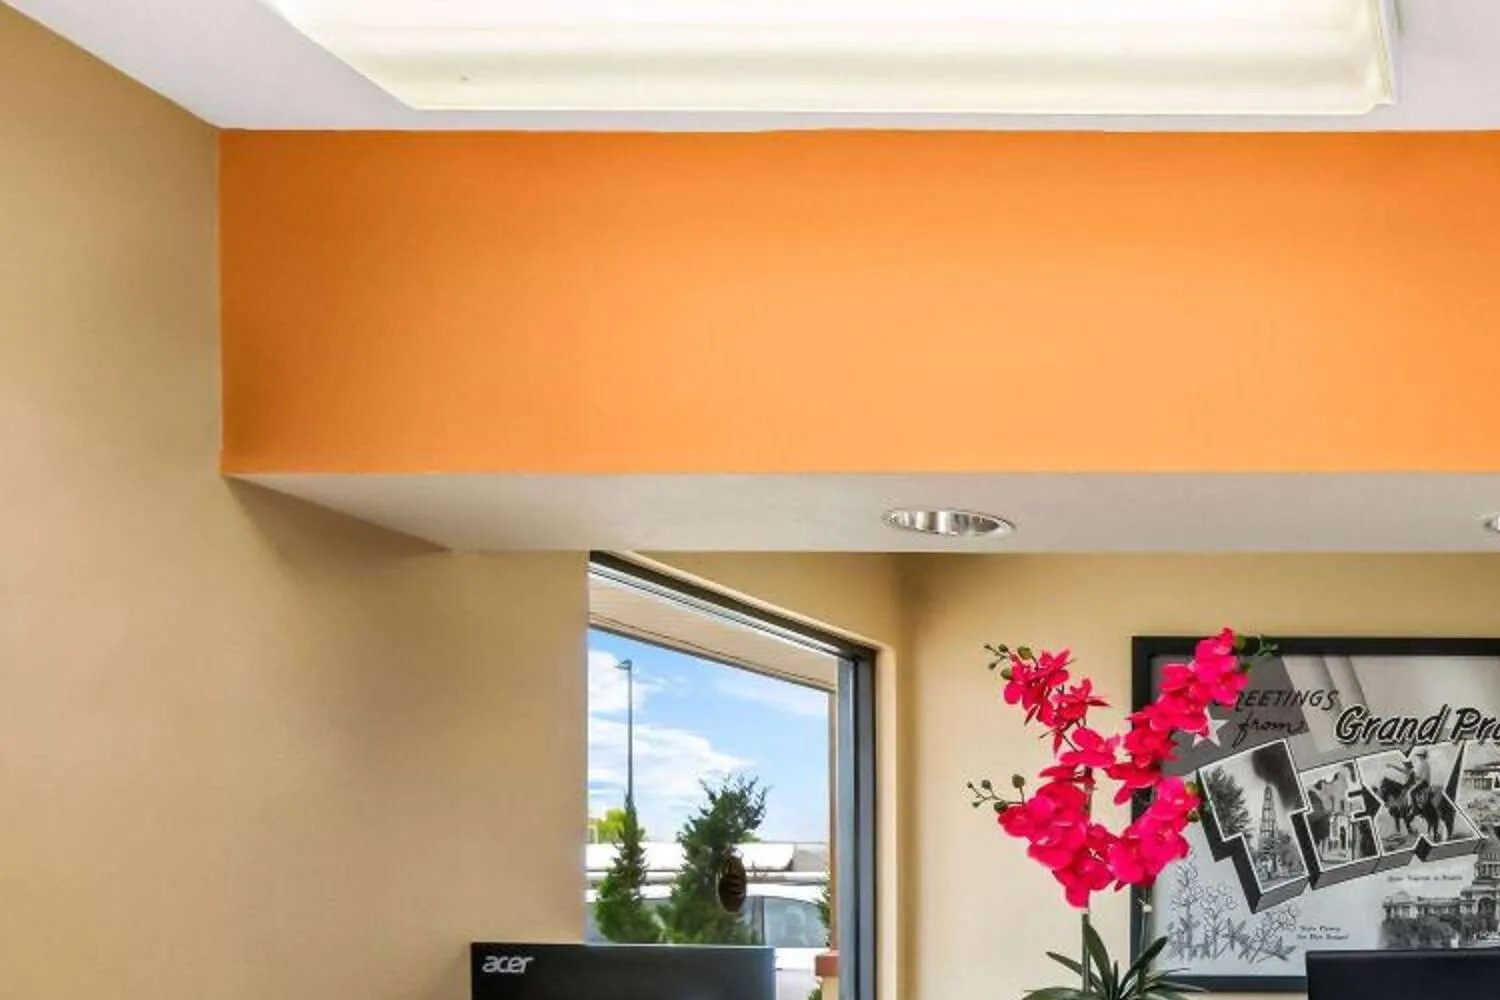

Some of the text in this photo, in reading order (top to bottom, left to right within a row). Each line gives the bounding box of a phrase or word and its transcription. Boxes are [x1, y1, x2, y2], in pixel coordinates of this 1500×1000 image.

[1212, 688, 1340, 713] EETINGS
[1231, 711, 1306, 748] from
[1333, 703, 1449, 744] Grand
[481, 955, 535, 974] acer
